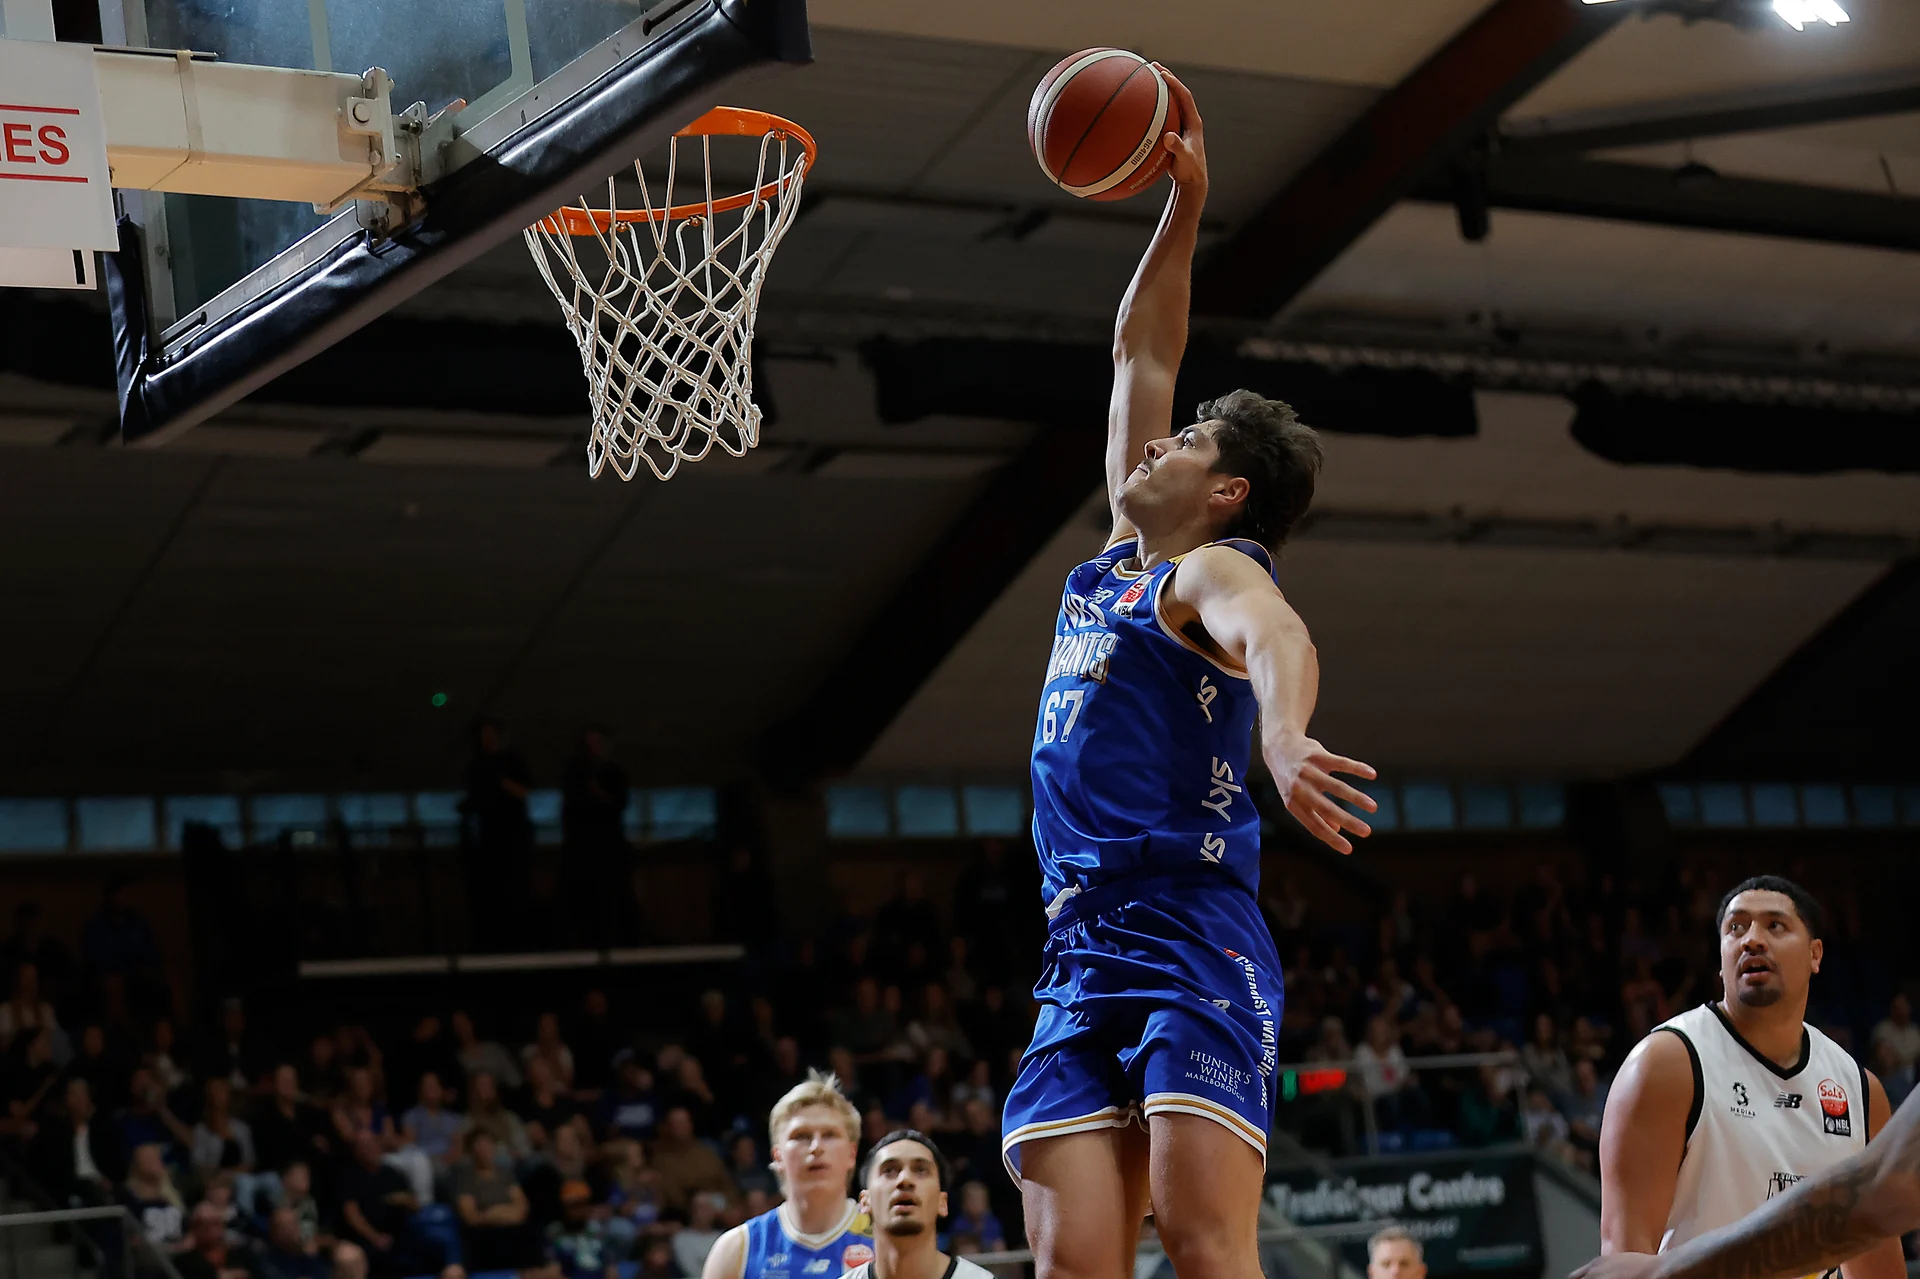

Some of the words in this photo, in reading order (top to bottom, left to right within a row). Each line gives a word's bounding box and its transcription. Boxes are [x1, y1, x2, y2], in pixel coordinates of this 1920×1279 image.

[0, 122, 70, 166] ES
[1042, 689, 1085, 744] 67
[1201, 756, 1242, 823] SKY
[1185, 1071, 1245, 1103] MARLBOROUGH
[1189, 1049, 1252, 1085] HUNTER'S
[1200, 1063, 1239, 1090] WINES
